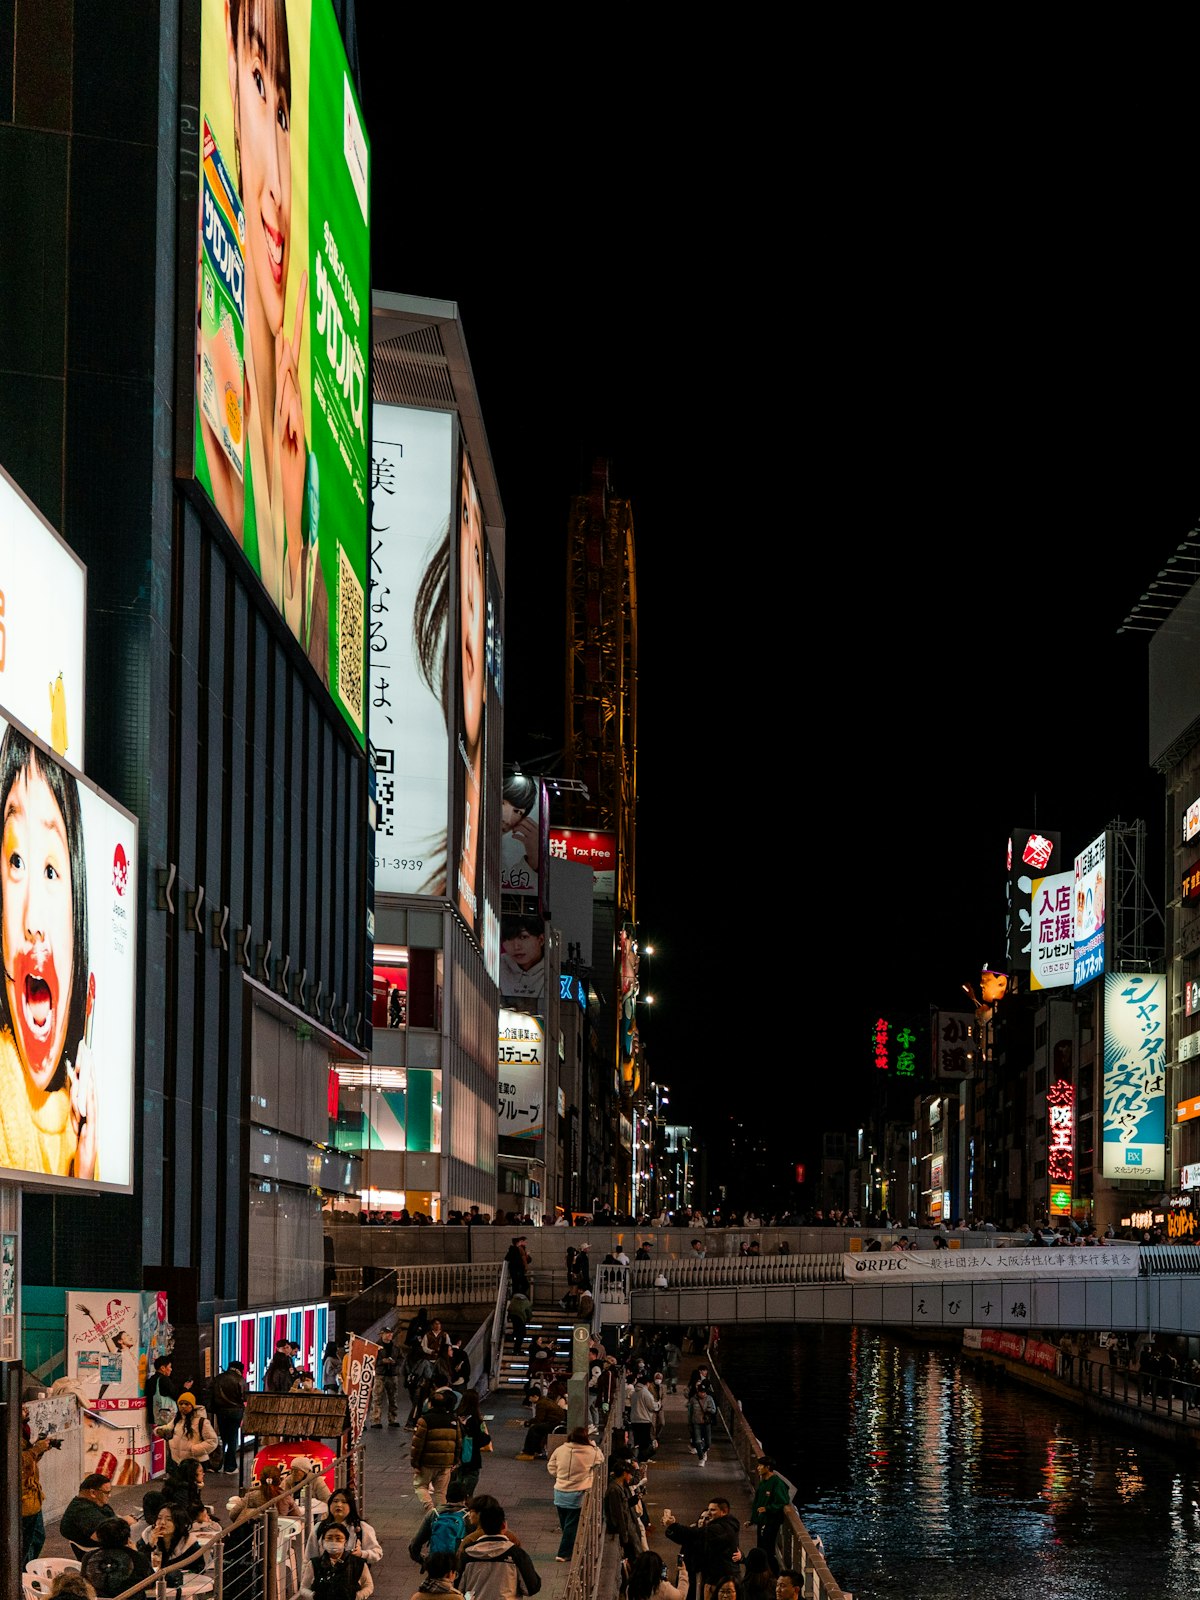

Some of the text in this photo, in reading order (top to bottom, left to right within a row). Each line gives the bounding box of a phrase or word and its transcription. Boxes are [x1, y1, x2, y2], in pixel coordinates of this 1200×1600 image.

[315, 250, 366, 449] サロンパス
[573, 847, 611, 858] Tax Free
[1039, 885, 1071, 916] 入店
[1182, 875, 1191, 899] 7F
[1038, 912, 1075, 944] 応援
[1075, 948, 1104, 986] ガルフネット
[1120, 977, 1166, 1096] シャッターは
[1046, 1079, 1073, 1181] 大阪王将
[1113, 1165, 1156, 1176] 文化シャッター
[1127, 1151, 1142, 1163] BX
[996, 1253, 1132, 1268] 大阪活性化事業実行委員会
[916, 1298, 1028, 1319] えびす橋
